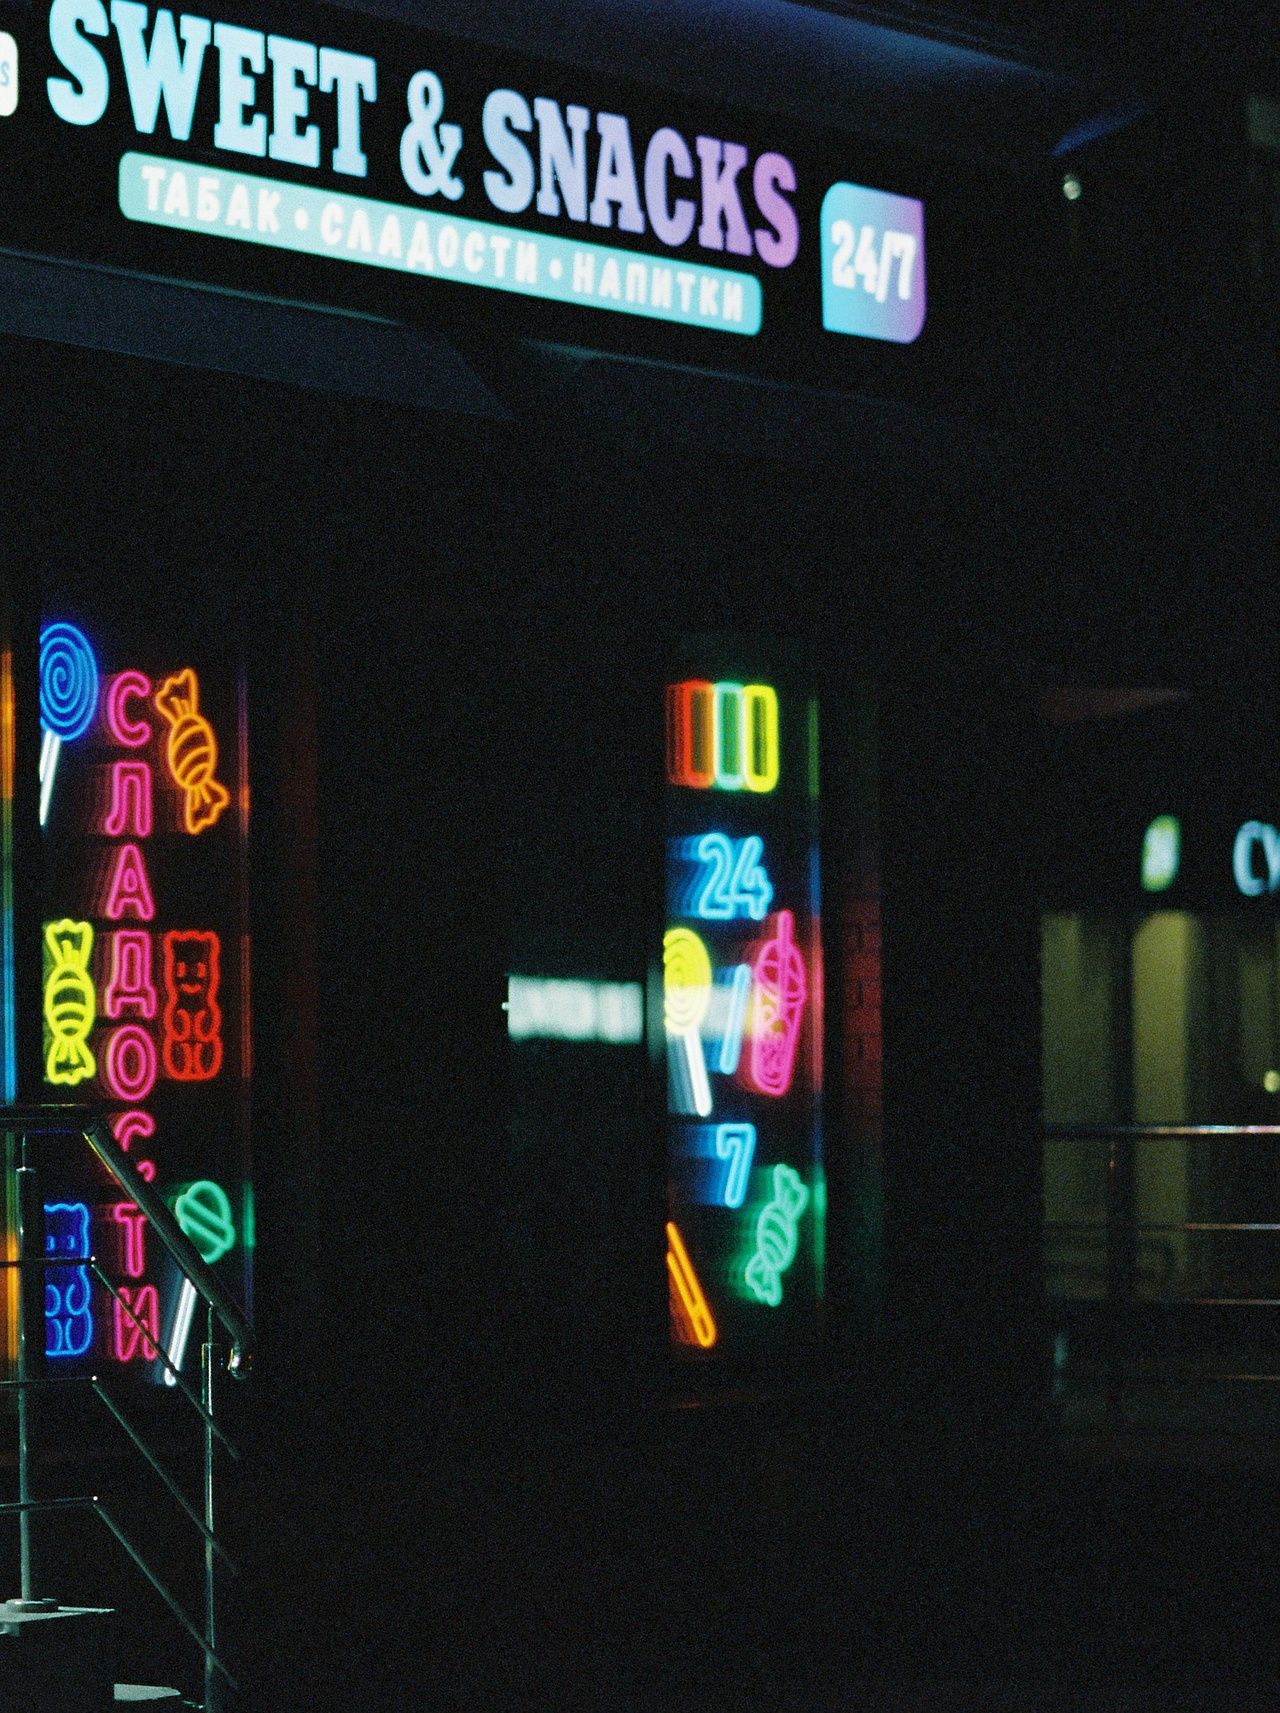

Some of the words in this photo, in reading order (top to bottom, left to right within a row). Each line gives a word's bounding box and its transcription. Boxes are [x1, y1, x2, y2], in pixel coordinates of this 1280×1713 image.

[46, 0, 376, 178] SWEET
[399, 69, 465, 201] &
[482, 88, 800, 269] SNACKS
[141, 165, 282, 234] ТАБАК
[320, 201, 538, 286] СЛАДОСТИ
[572, 250, 744, 324] НАПИТКИ
[831, 219, 918, 304] 24/7
